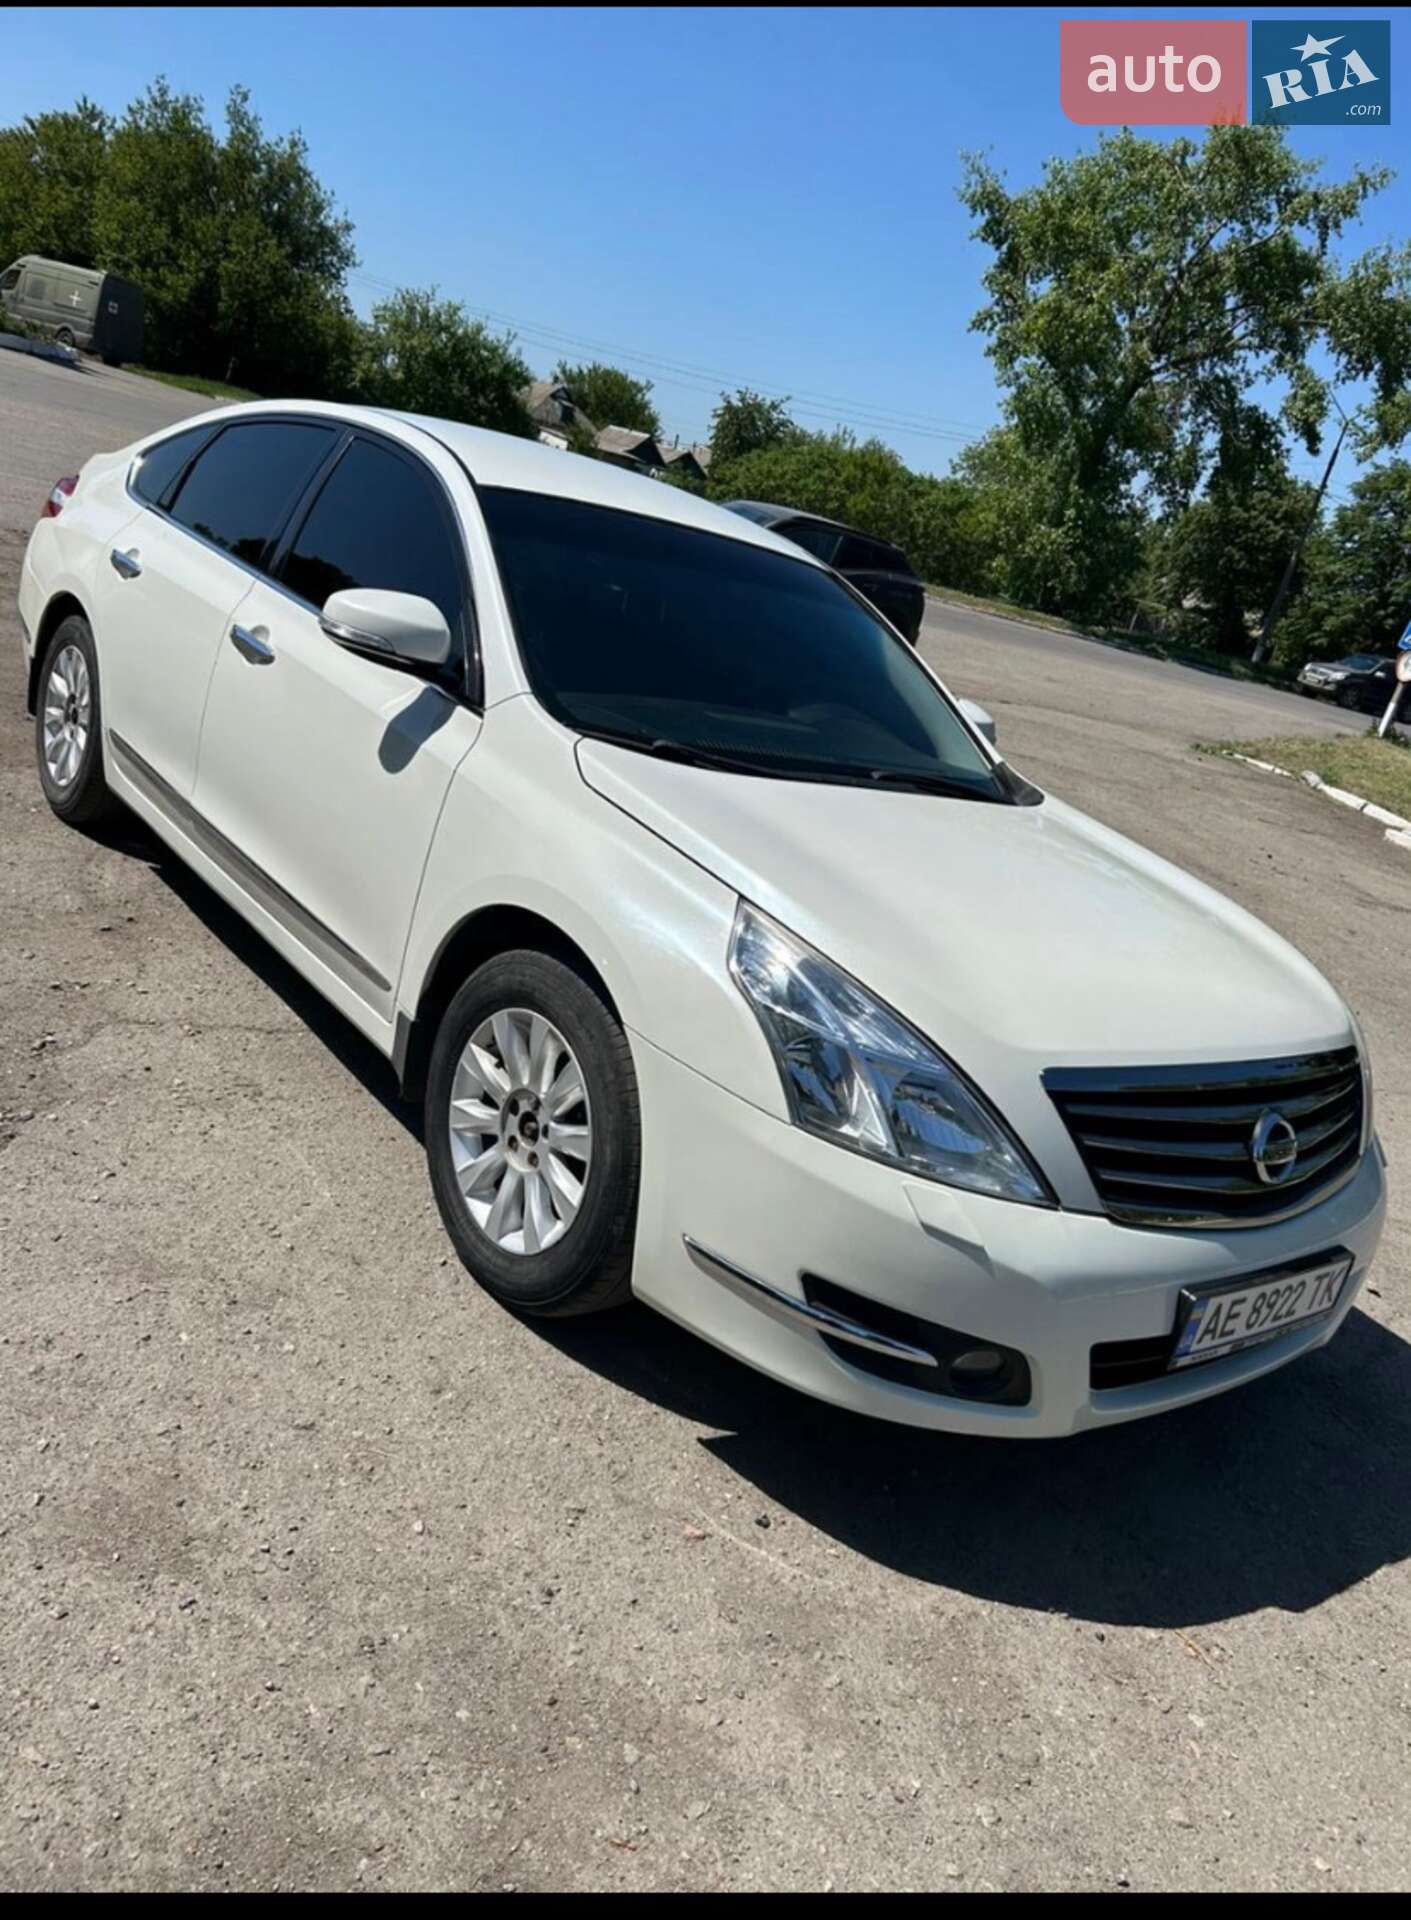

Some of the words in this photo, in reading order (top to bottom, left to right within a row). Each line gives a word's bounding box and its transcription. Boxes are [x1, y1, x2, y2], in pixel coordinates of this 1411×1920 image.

[1196, 1297, 1248, 1345] AE
[1246, 1281, 1306, 1331] 8922
[1308, 1267, 1345, 1311] TK
